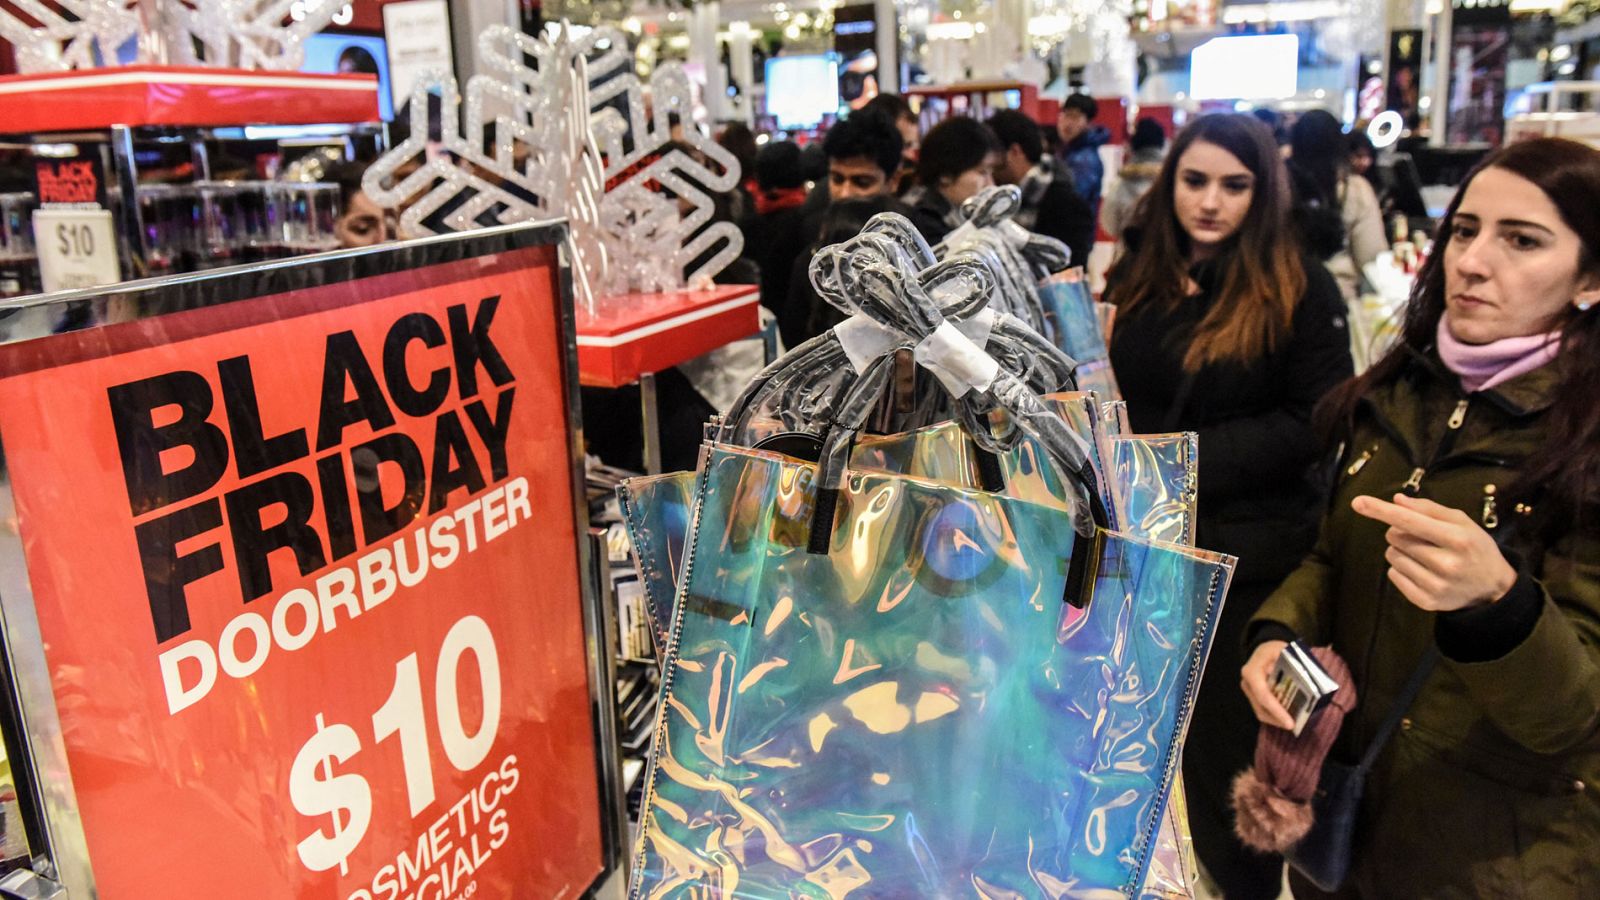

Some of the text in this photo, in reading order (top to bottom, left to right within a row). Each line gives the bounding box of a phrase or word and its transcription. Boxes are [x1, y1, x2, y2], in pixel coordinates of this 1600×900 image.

[37, 161, 96, 183] BLACK
[56, 223, 95, 256] $10
[107, 295, 516, 517] BLACK
[134, 387, 516, 644] FRIDAY
[158, 476, 532, 715] DOORBUSTER
[289, 615, 501, 877] $10
[346, 754, 520, 900] SMETICS
[403, 808, 509, 900] CIALS
